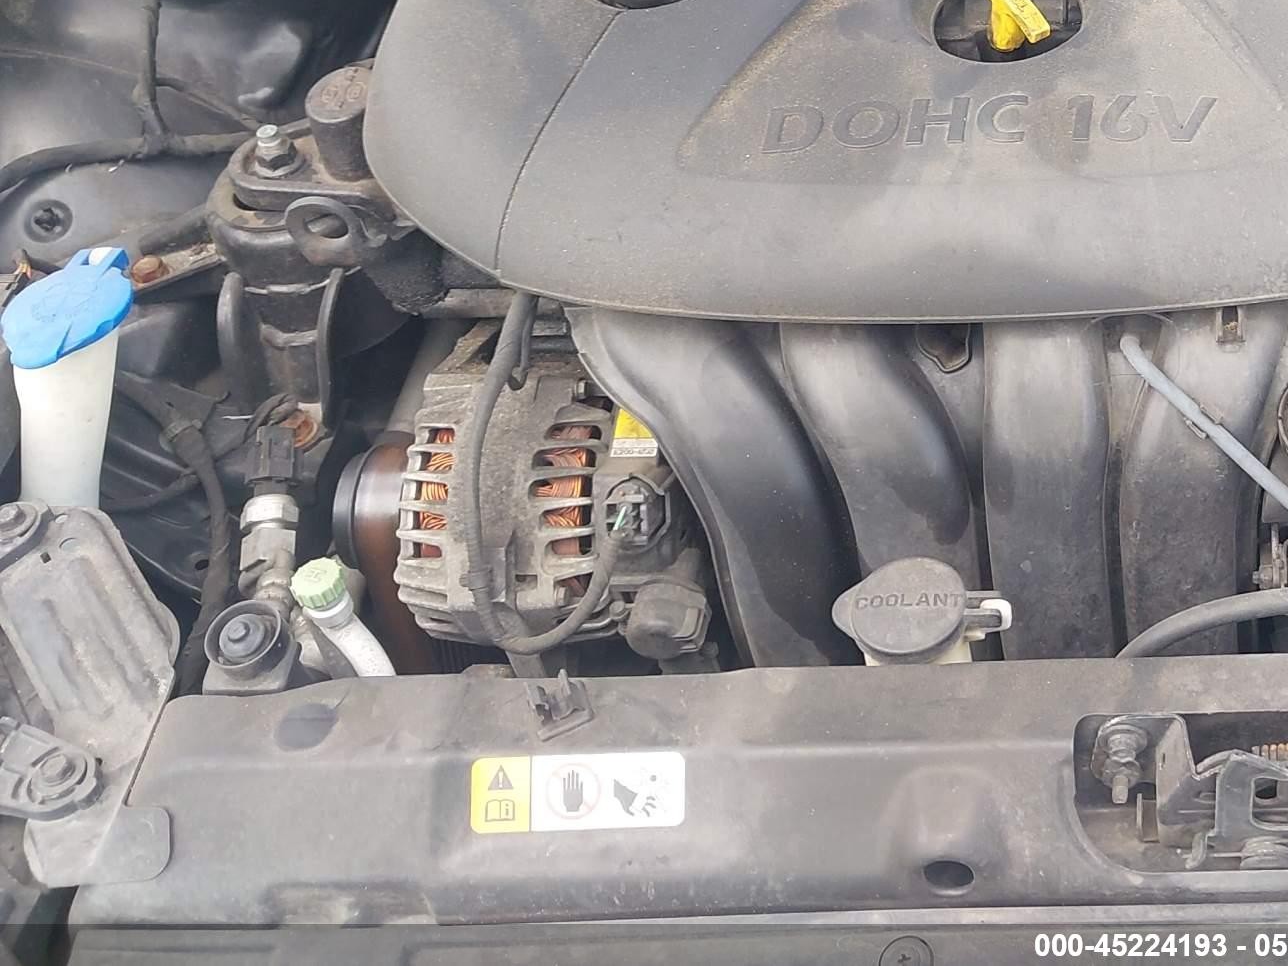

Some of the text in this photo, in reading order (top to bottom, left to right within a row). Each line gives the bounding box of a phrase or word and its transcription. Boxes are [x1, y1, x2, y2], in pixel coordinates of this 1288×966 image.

[760, 93, 1217, 154] DOHC 16V
[855, 593, 963, 611] COOLANT
